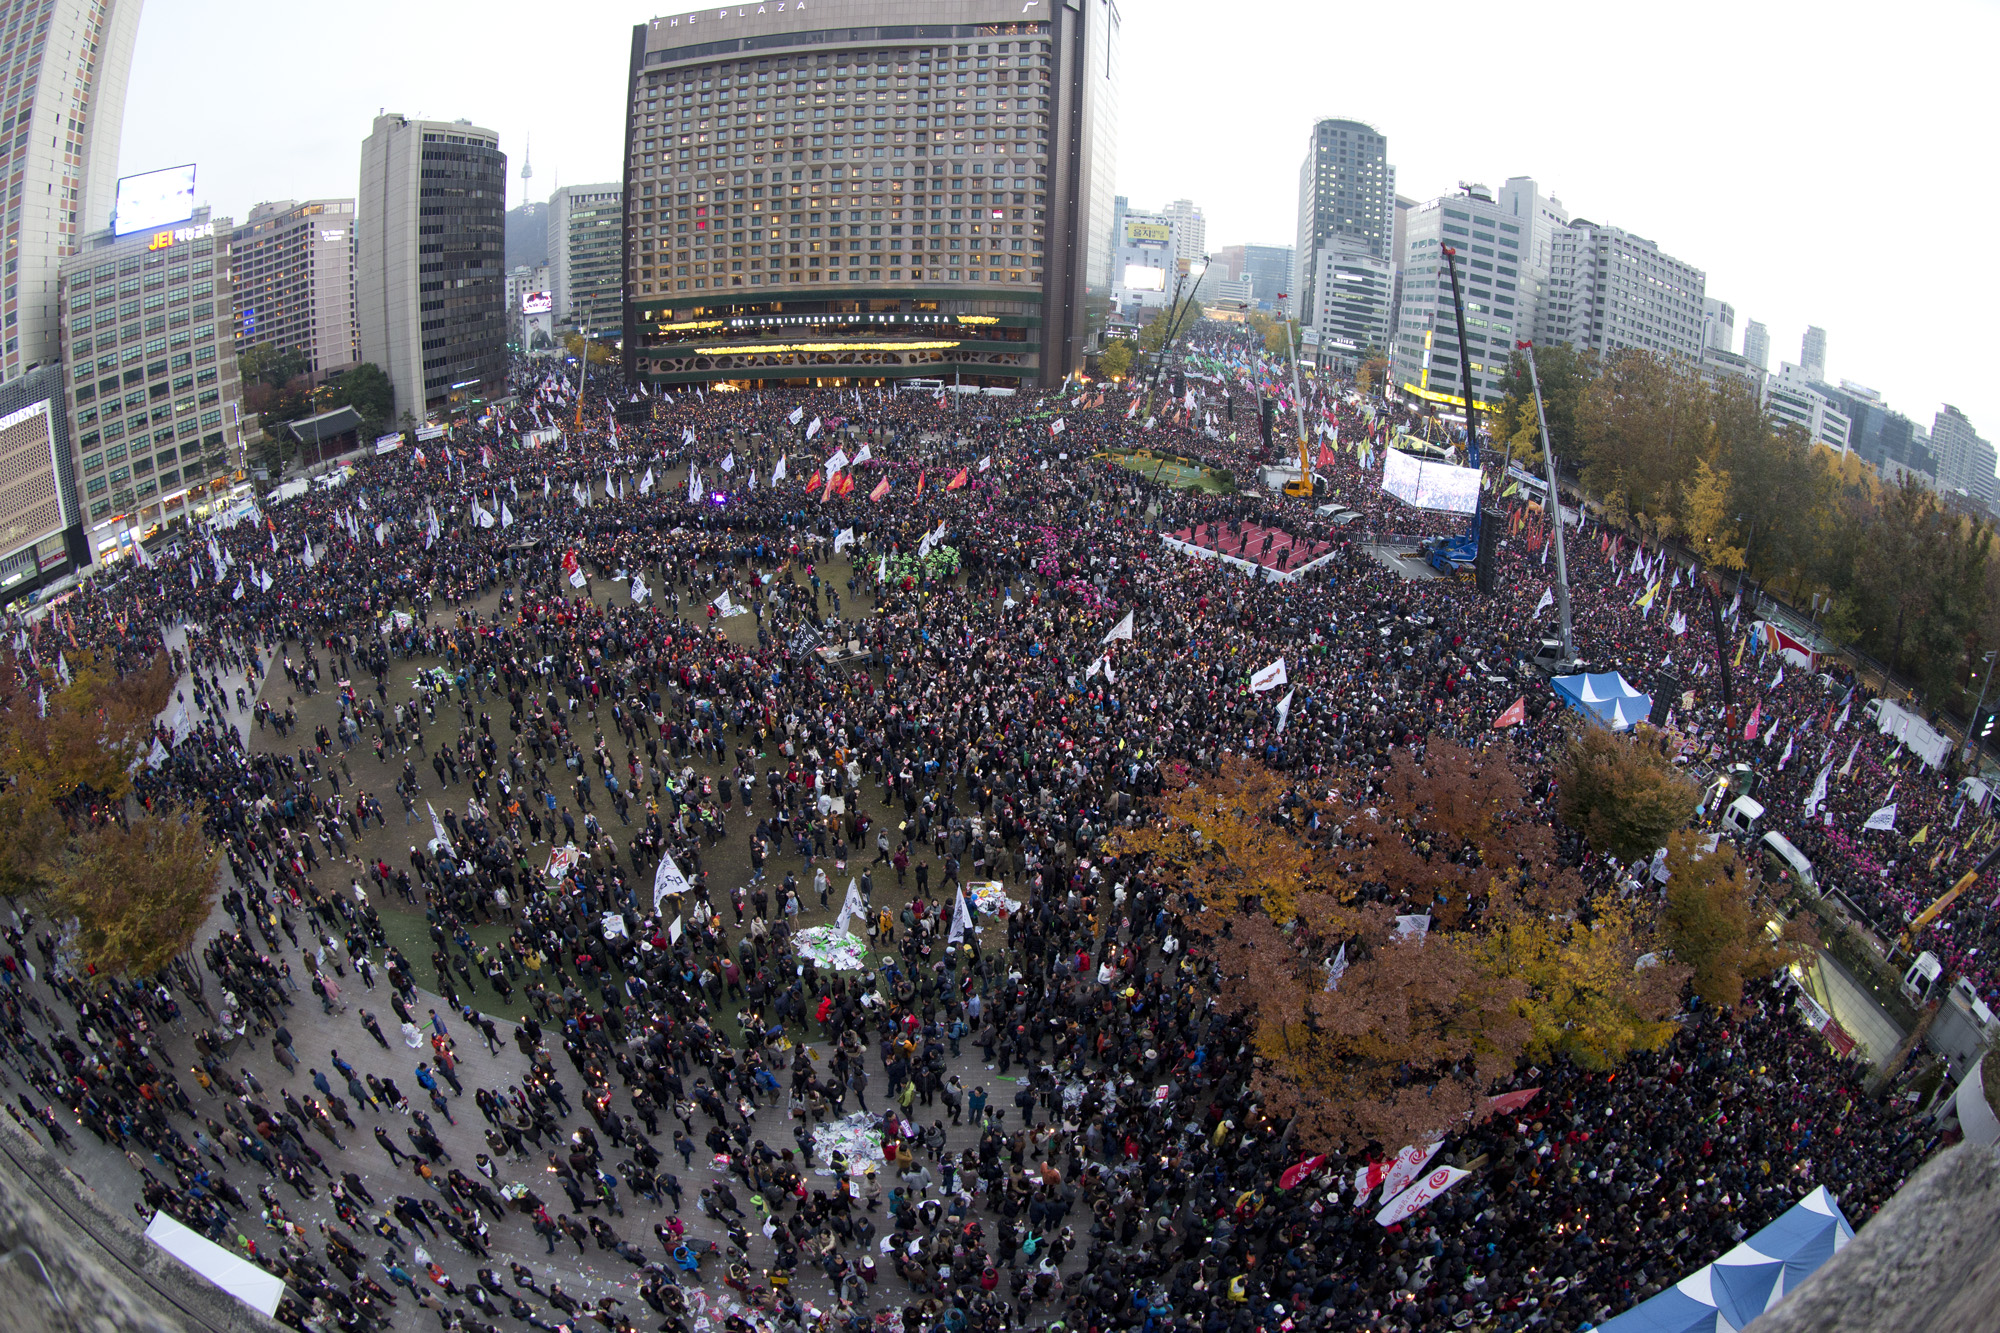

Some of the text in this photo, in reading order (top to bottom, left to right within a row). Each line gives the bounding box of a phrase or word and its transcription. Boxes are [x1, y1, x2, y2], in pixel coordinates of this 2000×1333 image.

[653, 1, 806, 31] THE PLAZA
[148, 230, 174, 251] JEI
[760, 315, 843, 325] ANNIVERSARY
[848, 315, 861, 323] OF
[869, 315, 895, 323] THE
[904, 315, 949, 323] PLAZA
